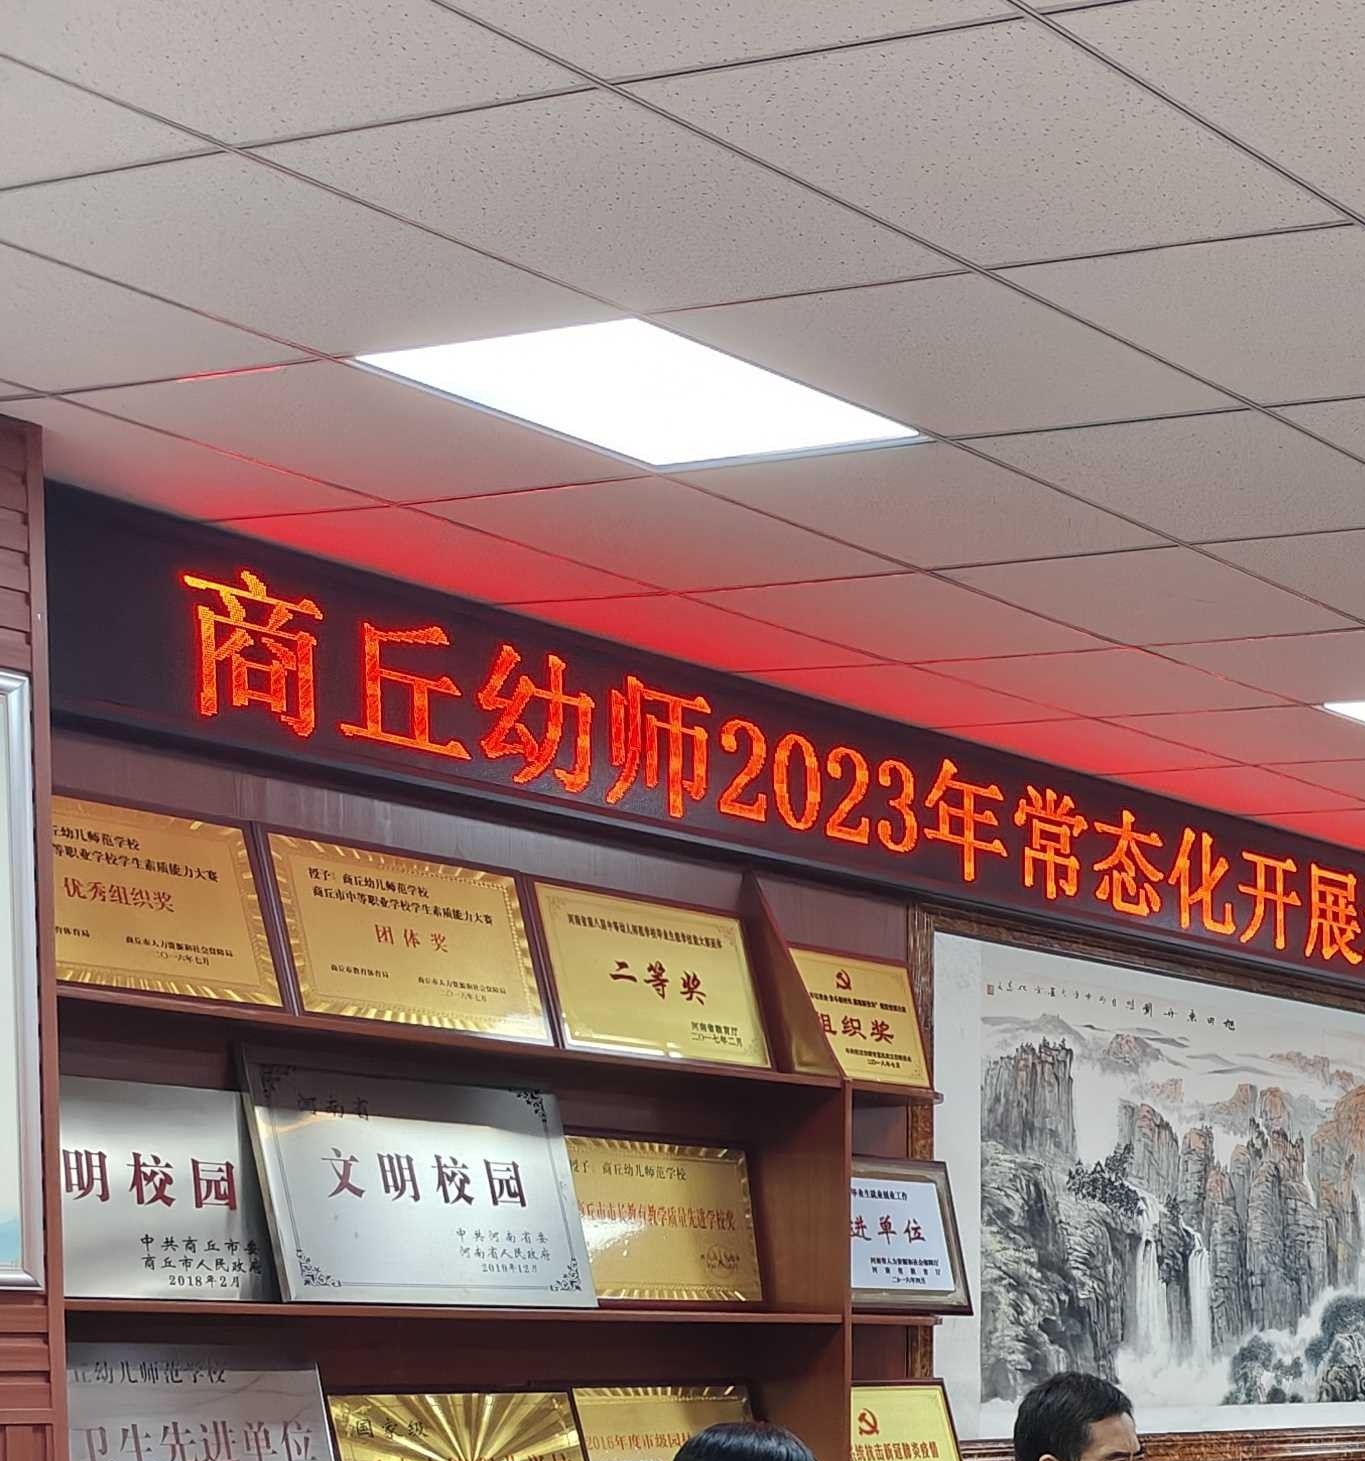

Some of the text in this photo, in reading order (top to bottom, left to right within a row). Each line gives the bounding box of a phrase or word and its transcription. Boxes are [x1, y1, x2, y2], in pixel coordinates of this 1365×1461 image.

[63, 877, 175, 913] 优秀组织奖
[343, 874, 429, 898] 商丘幼儿师范学校
[313, 886, 493, 926] 商丘市中等职业学校学生素质能力大赛
[374, 924, 448, 953] 团体奖
[609, 960, 707, 1005] 二等奖
[297, 1096, 369, 1121] 河南省
[62, 1149, 237, 1211] 明校园
[321, 1147, 527, 1207] 文明校园
[602, 1162, 688, 1181] 商丘幼儿师范学校
[456, 1227, 549, 1244] 中共河南省委
[850, 1216, 927, 1245] 进单位
[140, 1234, 261, 1256] 中共商丘市委
[460, 1246, 551, 1262] 河南省人民政府
[141, 1255, 264, 1275] 商丘市人民政府
[169, 1275, 241, 1289] 2018年2月
[355, 1418, 430, 1440] 国家级
